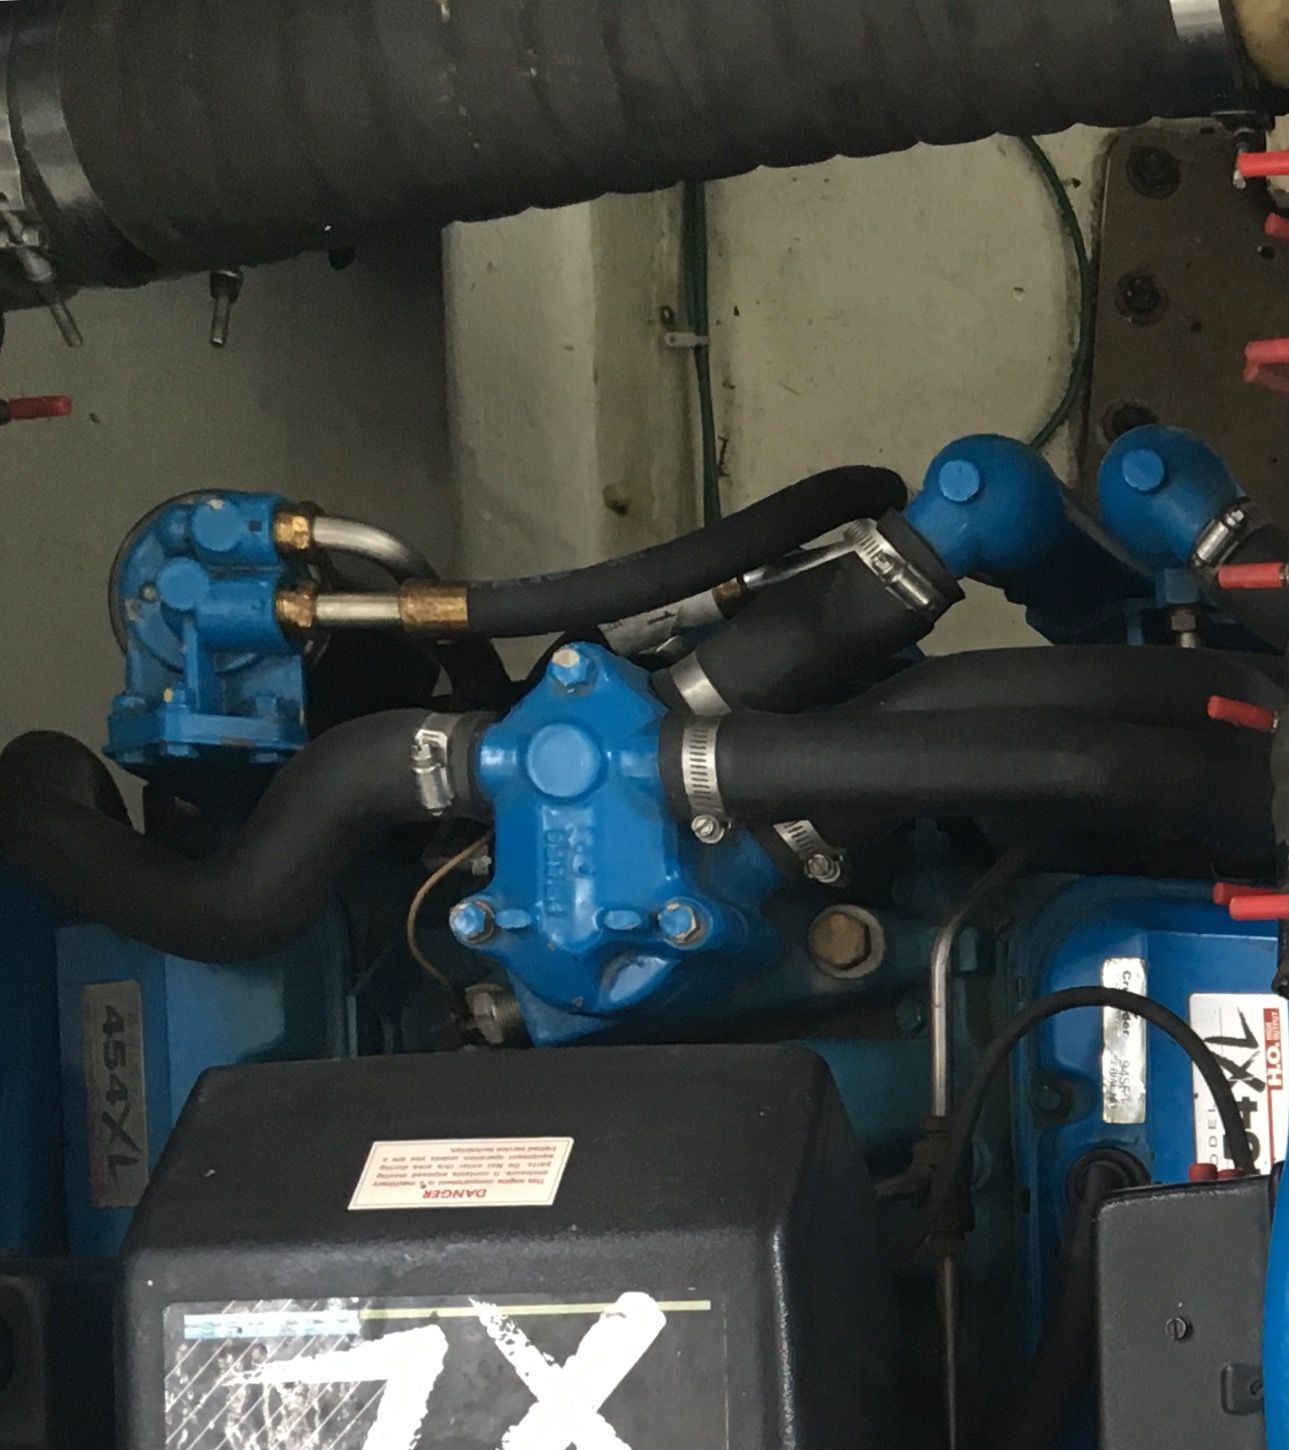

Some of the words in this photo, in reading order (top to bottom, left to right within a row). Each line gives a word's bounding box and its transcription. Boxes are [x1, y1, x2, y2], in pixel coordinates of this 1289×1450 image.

[1121, 970, 1132, 1036] Crder
[1266, 1042, 1283, 1086] H.O.
[1207, 1103, 1218, 1165] ODEL
[422, 1189, 487, 1199] DANGER
